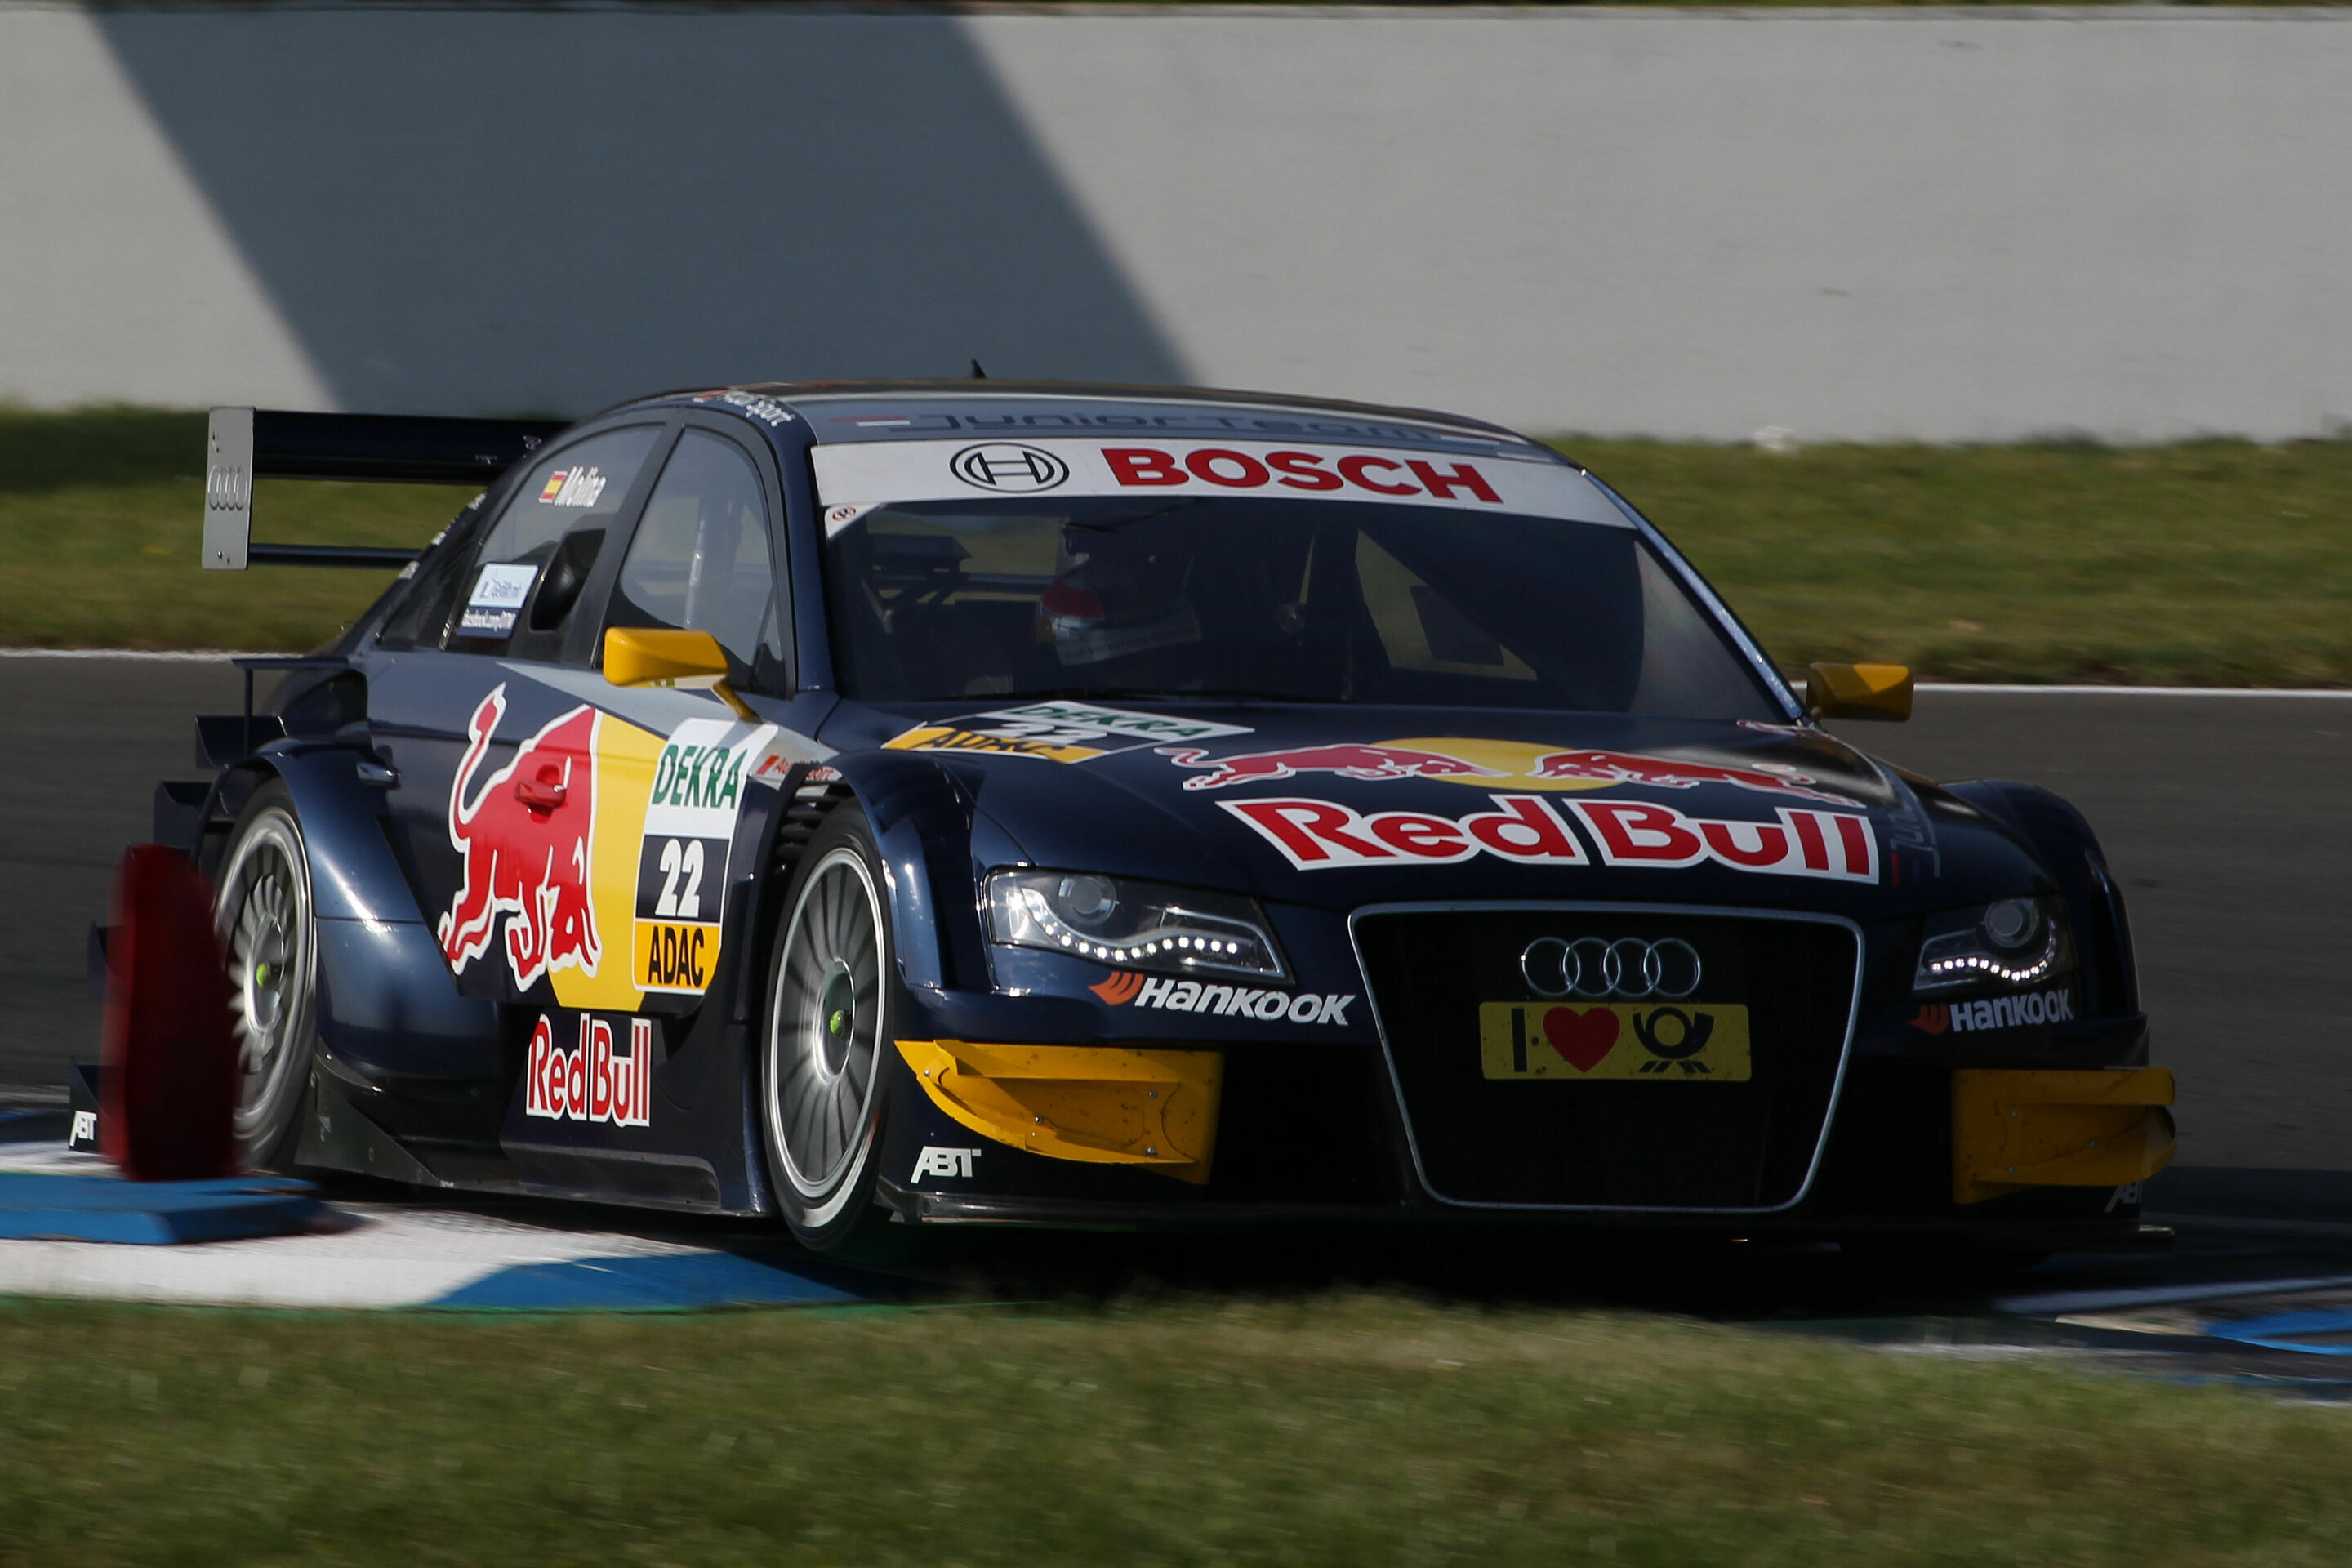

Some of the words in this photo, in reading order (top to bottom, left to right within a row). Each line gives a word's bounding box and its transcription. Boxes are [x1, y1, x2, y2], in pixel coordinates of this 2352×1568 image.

[1101, 448, 1504, 504] BOSCH
[1005, 706, 1214, 737] DEKRA
[653, 742, 749, 810] DEKRA
[1223, 794, 1584, 866] Red
[1572, 797, 1873, 879] Bull
[654, 839, 705, 918] 22
[647, 926, 705, 988] ADAC
[527, 1013, 587, 1121] Red
[590, 1018, 651, 1126] Bull
[1511, 1007, 1527, 1073] I
[69, 1110, 97, 1147] ABT
[911, 1146, 981, 1183] ABT
